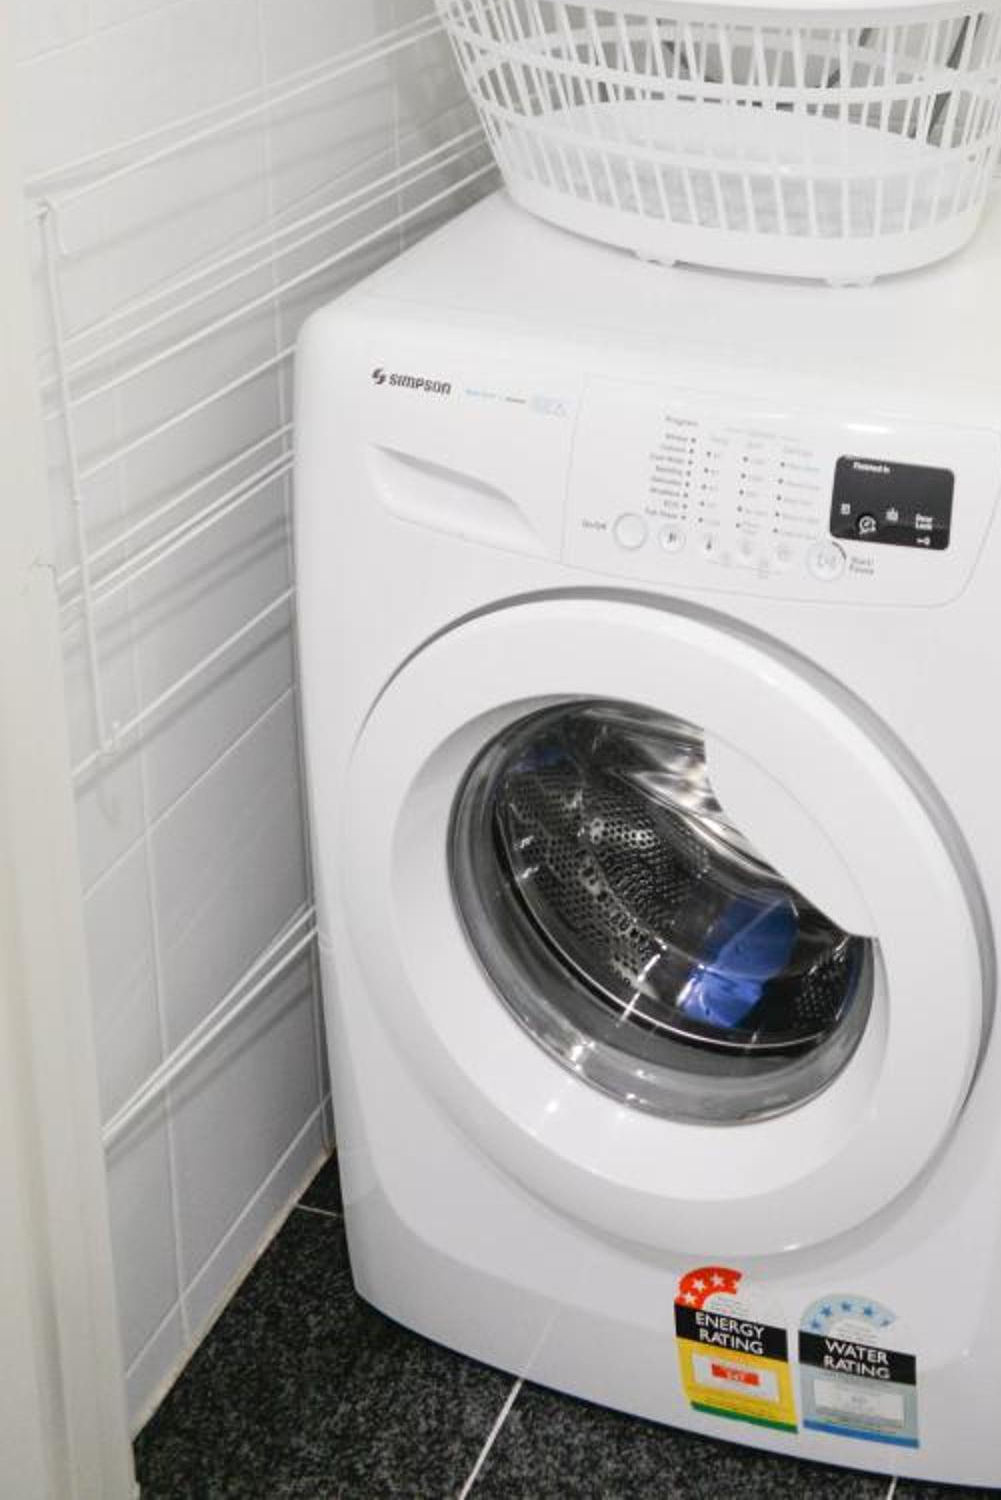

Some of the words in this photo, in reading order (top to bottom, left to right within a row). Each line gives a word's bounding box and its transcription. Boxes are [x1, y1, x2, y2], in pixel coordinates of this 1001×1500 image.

[389, 373, 452, 396] SIMPSON
[695, 1311, 767, 1340] ENERGY
[698, 1327, 764, 1355] RATING
[825, 1339, 889, 1365] WATER
[823, 1355, 891, 1380] RATING
